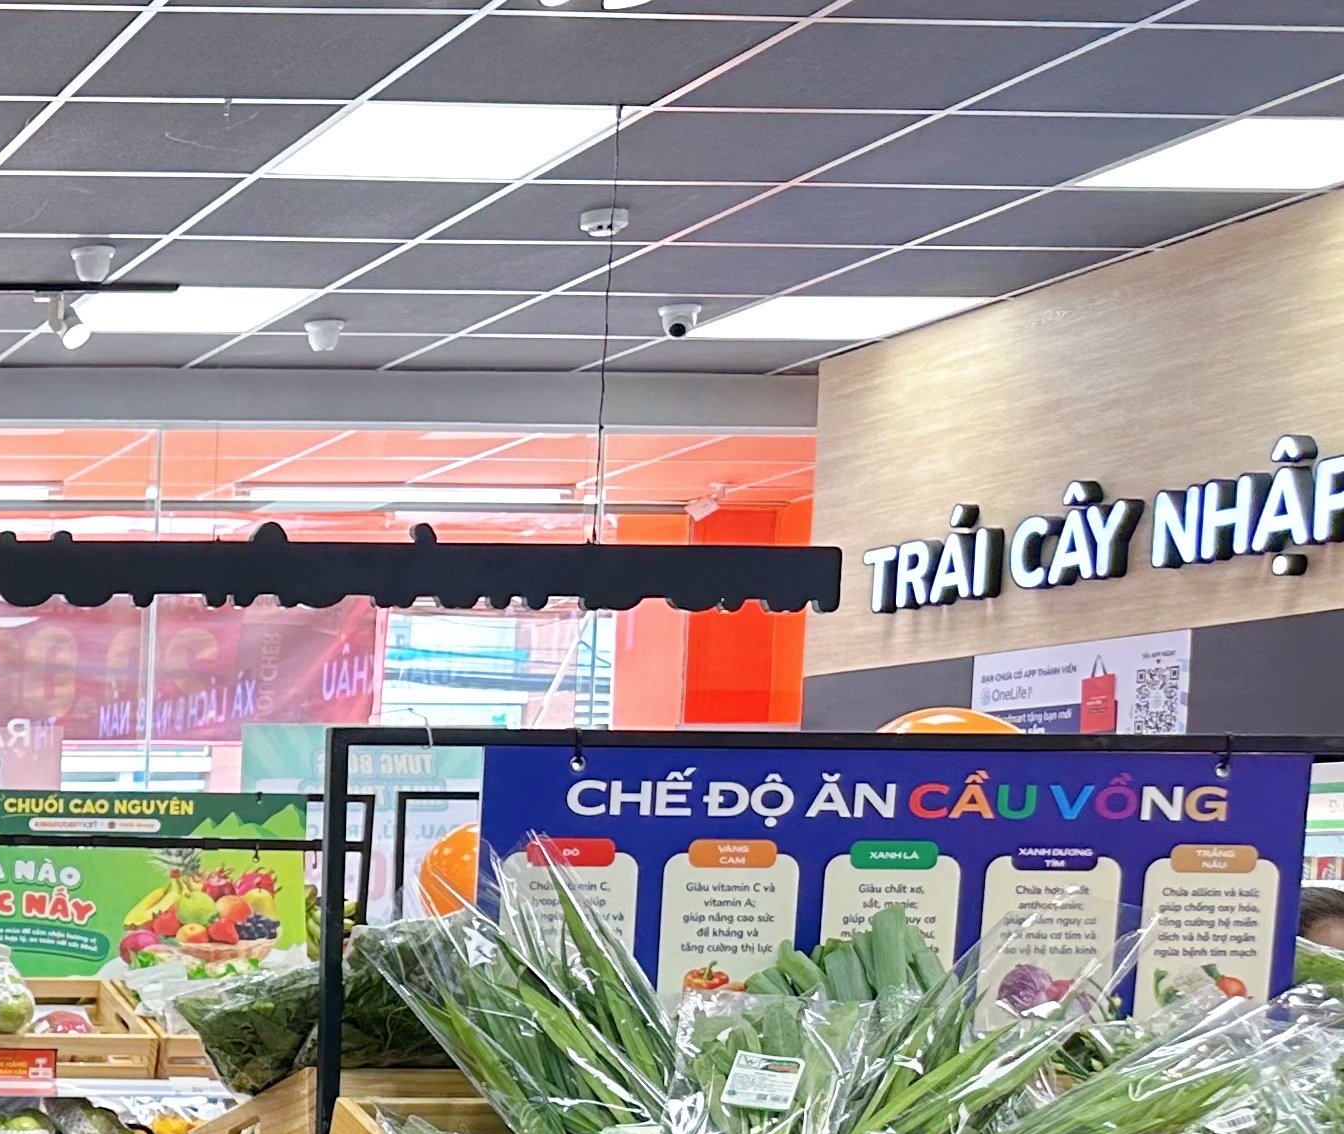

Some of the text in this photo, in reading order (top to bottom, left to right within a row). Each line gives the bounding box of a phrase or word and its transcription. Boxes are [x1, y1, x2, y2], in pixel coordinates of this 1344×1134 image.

[863, 435, 1344, 612] TRÁI CÂY NHẬP
[566, 767, 1229, 828] CHẾ ĐỘ ĂN CẦU VỒNG
[4, 794, 194, 816] CHUỐI CAO NGUYÊN
[717, 845, 750, 855] VÀNG
[903, 848, 920, 860] LÁ
[1044, 858, 1065, 868] TÍM
[14, 858, 81, 888] NÀO
[686, 882, 708, 893] Giàu
[712, 882, 751, 893] vitamin
[763, 882, 776, 893] và
[858, 883, 881, 894] Giàu
[884, 883, 907, 894] chất
[1015, 885, 1041, 896] Chứa
[1162, 887, 1188, 897] Chứa
[1224, 887, 1237, 897] và
[23, 886, 96, 925] NẤY
[704, 898, 743, 908] vitamin
[683, 912, 775, 924] giúp nâng cao sức
[842, 914, 865, 925] giúp
[1218, 917, 1231, 929] hệ
[696, 927, 759, 940] để kháng và
[1182, 932, 1194, 942] và
[680, 942, 773, 955] tăng cường thị lực
[1075, 945, 1097, 955] kinh
[1210, 948, 1226, 958] tim
